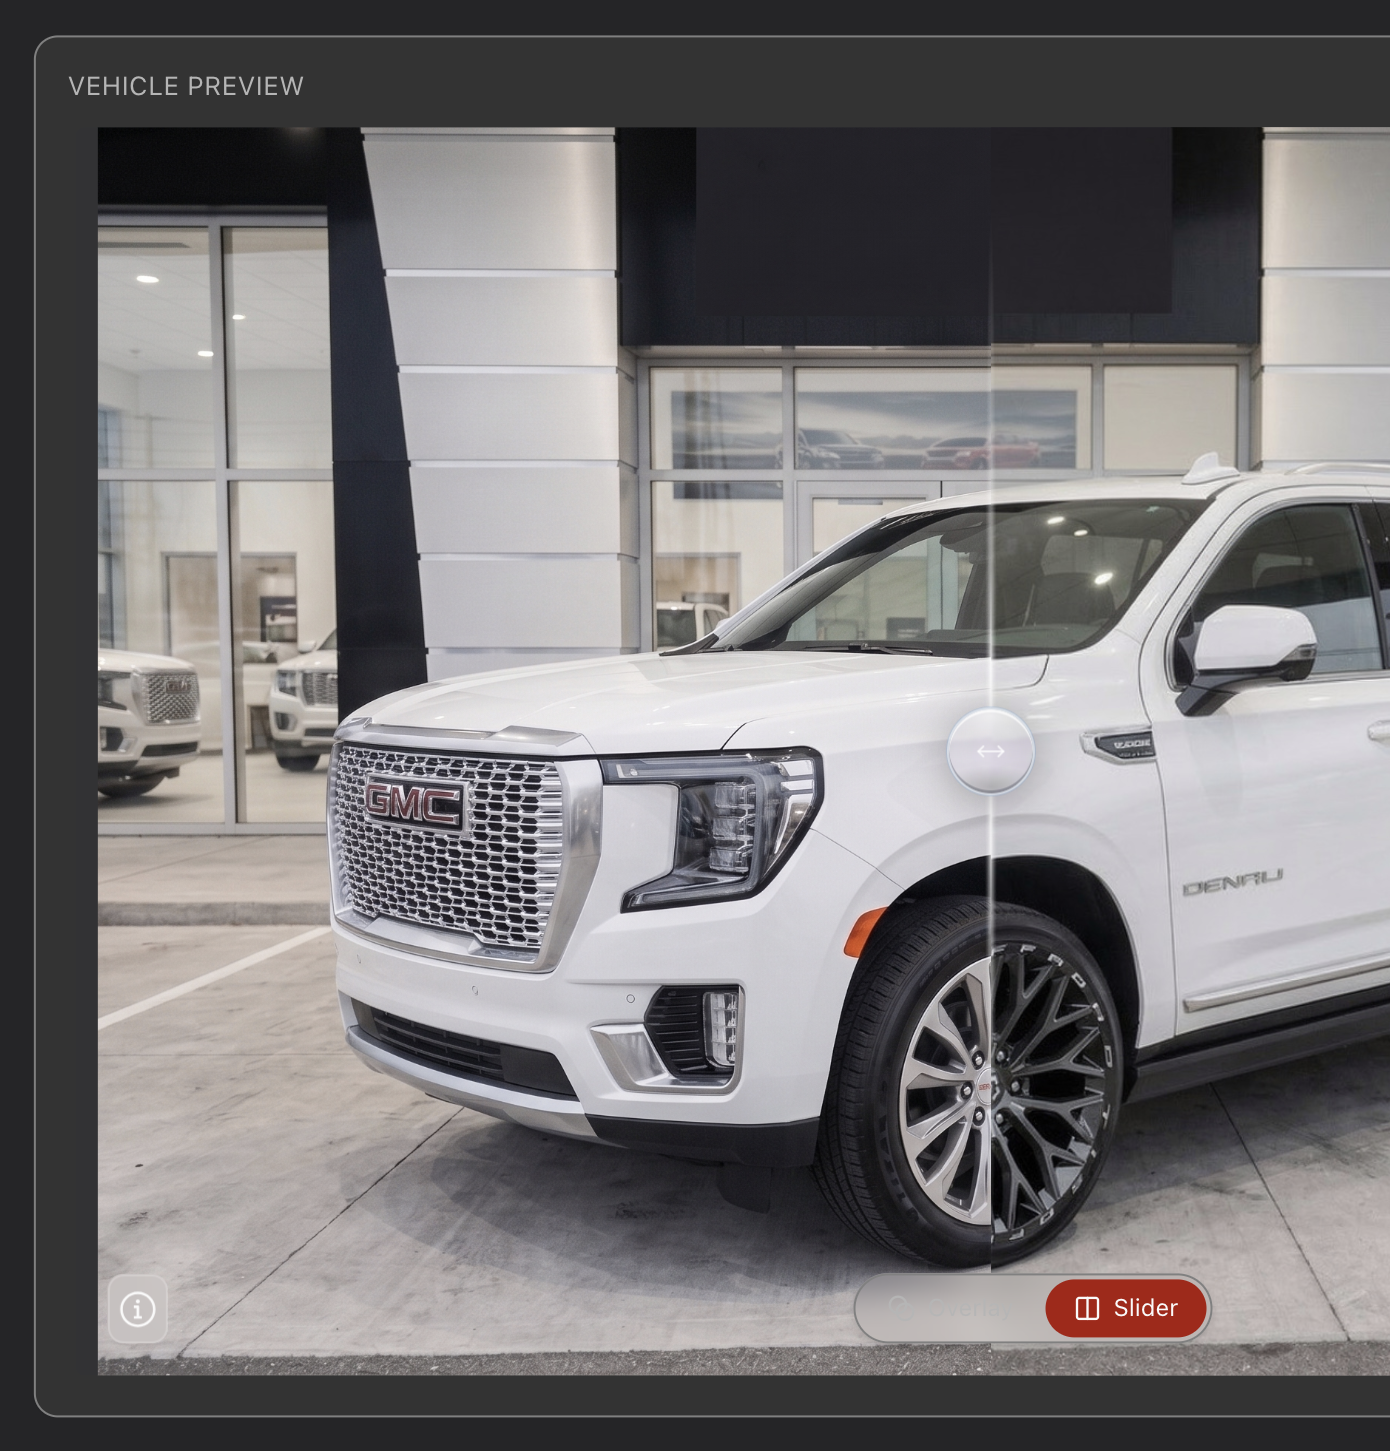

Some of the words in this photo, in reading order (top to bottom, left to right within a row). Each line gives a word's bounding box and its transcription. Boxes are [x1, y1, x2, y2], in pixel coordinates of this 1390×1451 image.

[68, 75, 178, 97] VEHICLE
[188, 75, 304, 96] PREVIEW
[365, 784, 460, 826] GMC
[929, 1298, 1013, 1321] Overlay
[1114, 1297, 1179, 1318] Slider
